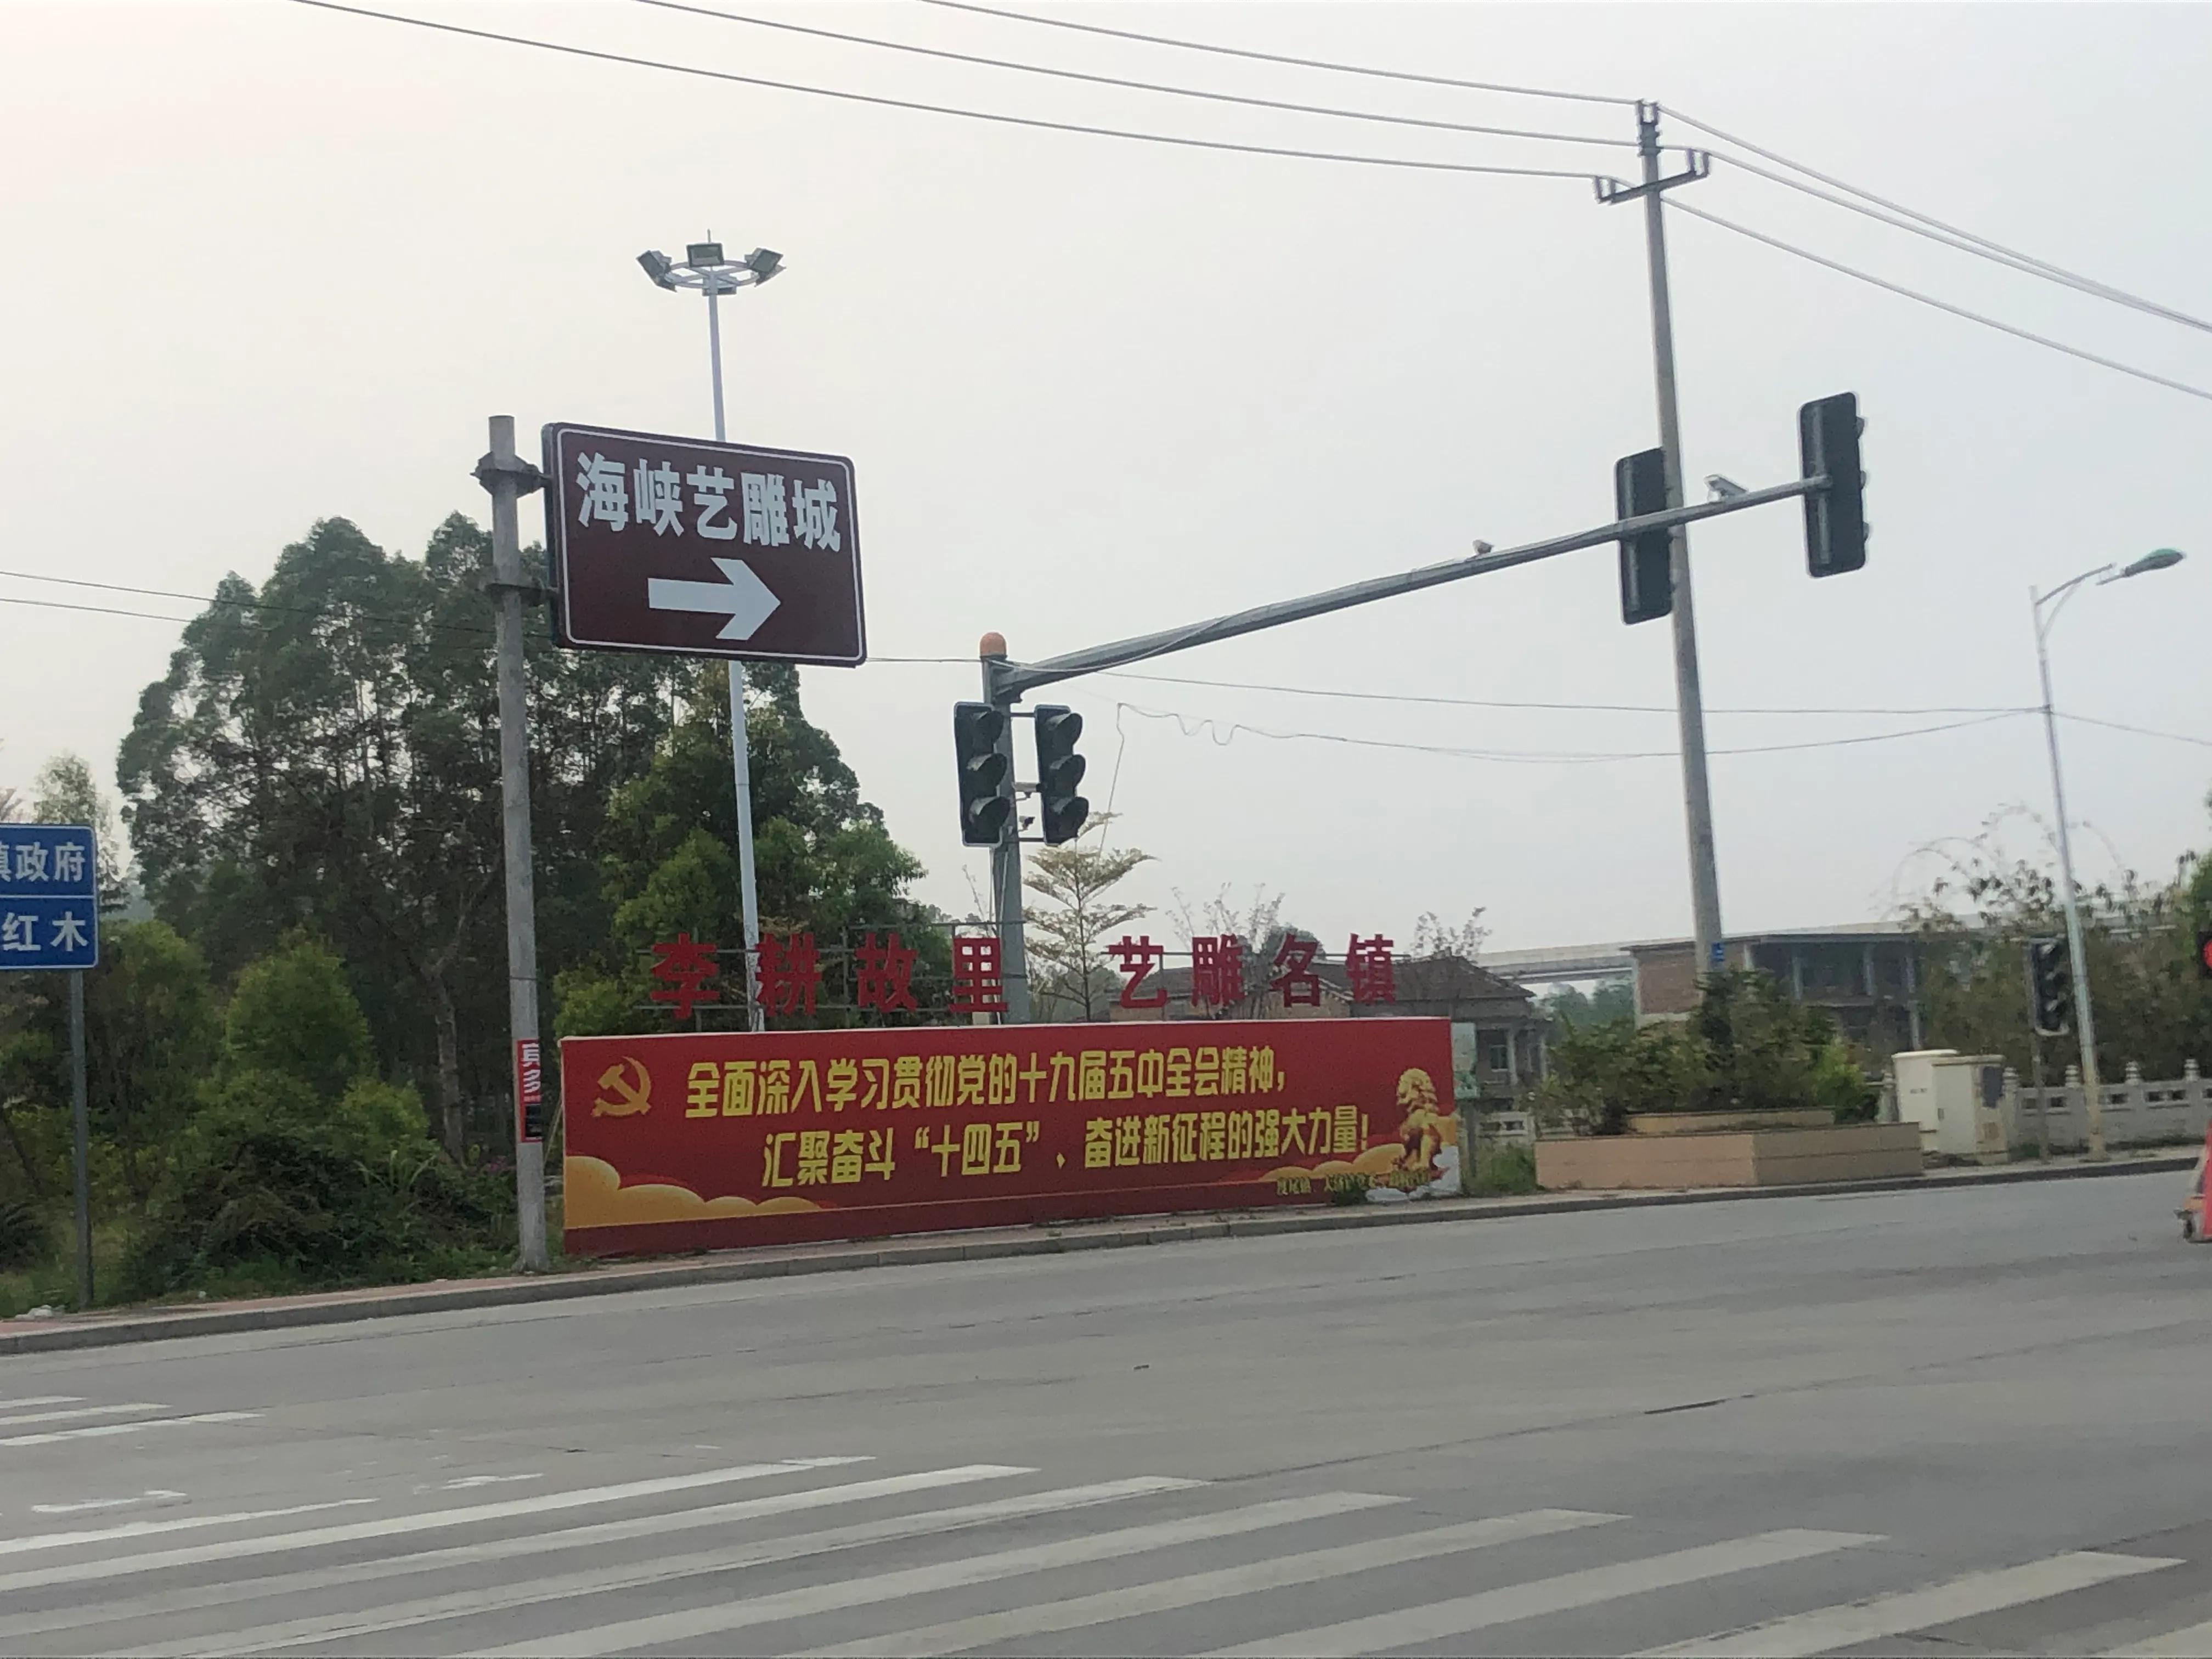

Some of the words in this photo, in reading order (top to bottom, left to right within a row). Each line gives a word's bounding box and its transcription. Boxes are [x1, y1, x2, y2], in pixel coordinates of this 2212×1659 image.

[575, 452, 841, 552] 海峡艺雕城
[2, 911, 88, 951] 红木
[650, 932, 1008, 1020] 李耕故里
[1108, 933, 1396, 1009] 艺雕名镇
